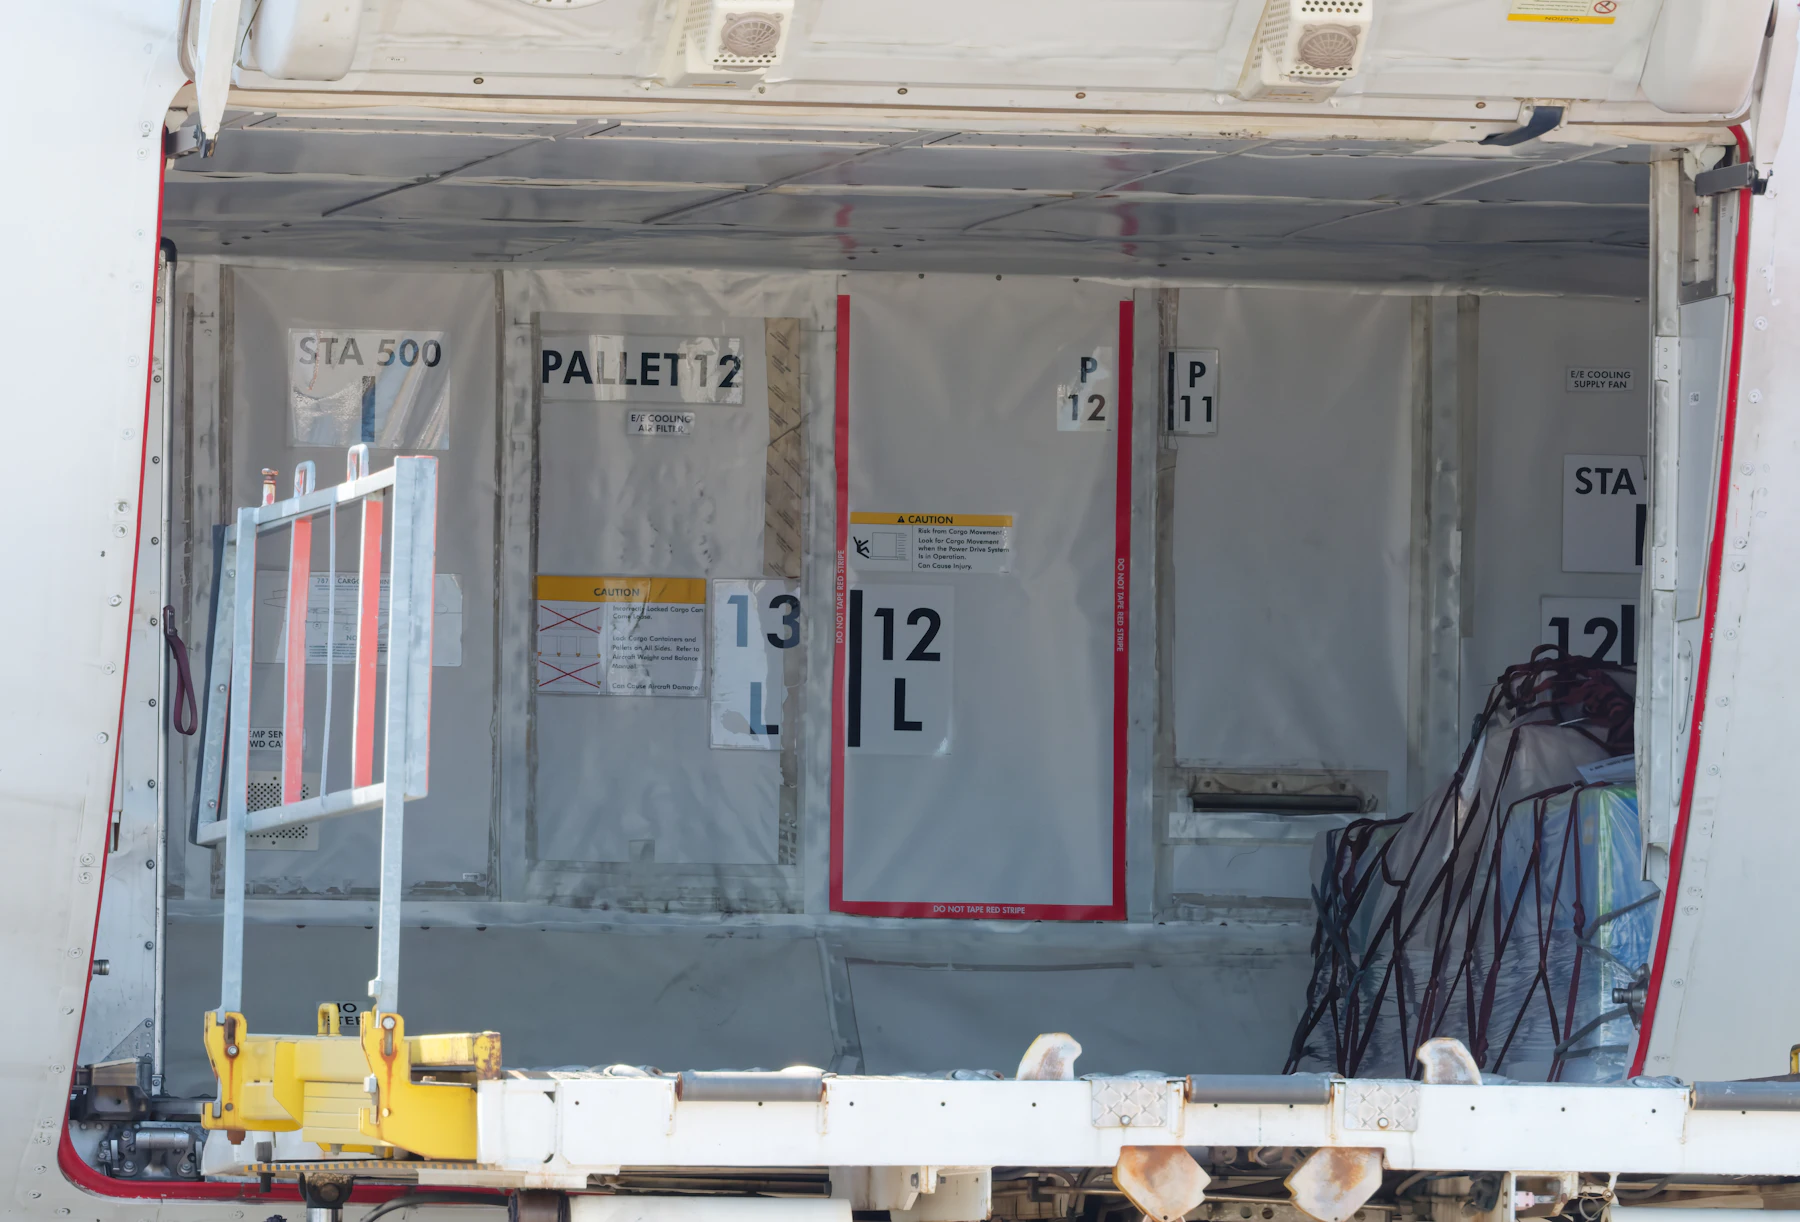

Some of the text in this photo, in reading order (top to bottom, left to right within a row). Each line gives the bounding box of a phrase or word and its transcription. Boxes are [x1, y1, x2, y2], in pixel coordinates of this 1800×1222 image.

[298, 336, 442, 368] STA 500
[541, 350, 686, 387] PALLET
[694, 353, 743, 389] 12
[1080, 356, 1098, 384] P
[1189, 361, 1207, 388] P
[1570, 370, 1632, 379] E/E COOLING
[1574, 380, 1627, 389] SUPPLY FAN
[1068, 393, 1106, 421] 12
[1180, 395, 1213, 423] 11
[630, 414, 692, 424] E/E COOLING
[637, 424, 684, 433] AIR FILTER
[1575, 466, 1637, 496] STA
[907, 515, 954, 524] CAUTION
[948, 528, 968, 537] Cargo
[945, 538, 965, 546] Cargo
[932, 553, 967, 561] Operation.
[987, 546, 1009, 554] System
[837, 549, 845, 573] STRIPE
[952, 563, 973, 571] Injury.
[1117, 557, 1125, 571] DO
[1117, 572, 1125, 590] NOT
[593, 587, 641, 598] CAUTION
[670, 606, 690, 614] Cargo
[726, 593, 801, 649] 13
[836, 612, 844, 628] NOT
[1116, 611, 1124, 626] RED
[836, 631, 843, 644] DO
[873, 607, 942, 662] 12
[1116, 628, 1124, 652] STRIPE
[1548, 616, 1619, 667] 12
[749, 681, 780, 735] L
[893, 677, 923, 732] L
[933, 904, 1026, 915] DO NOT TAPE RED STRIPE
